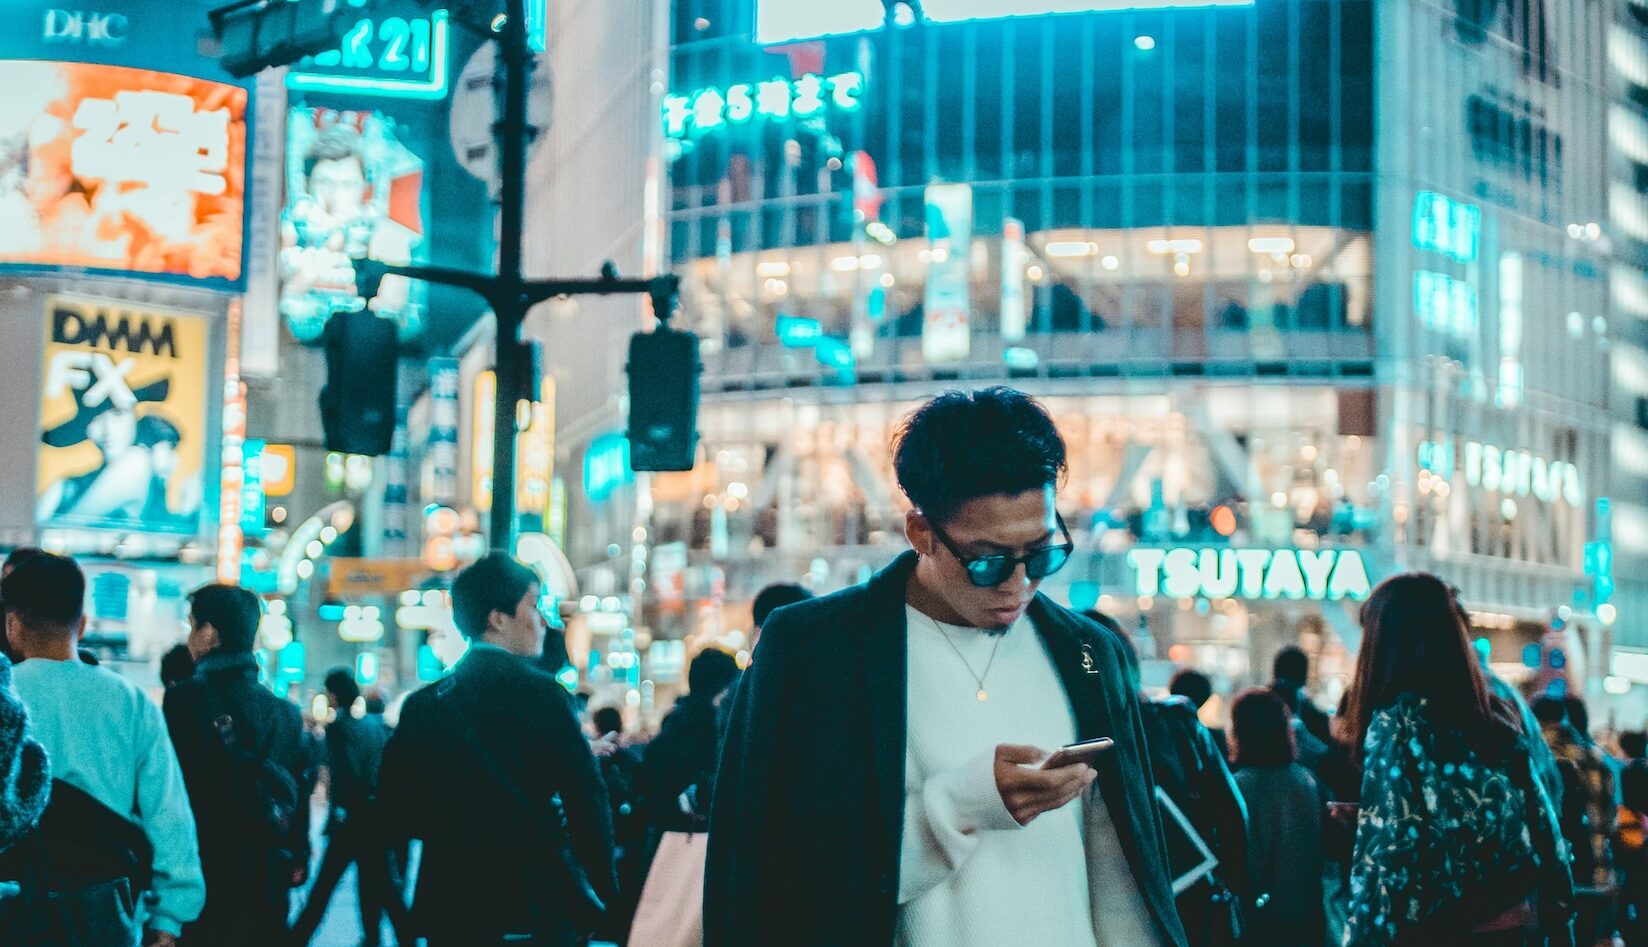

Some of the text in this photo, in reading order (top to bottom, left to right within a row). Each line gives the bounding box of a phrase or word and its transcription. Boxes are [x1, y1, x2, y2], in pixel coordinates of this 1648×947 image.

[44, 8, 128, 40] DHC
[378, 17, 430, 73] 21
[52, 309, 177, 358] DMM
[47, 350, 138, 407] FX
[1127, 547, 1371, 600] TSUTAYA
